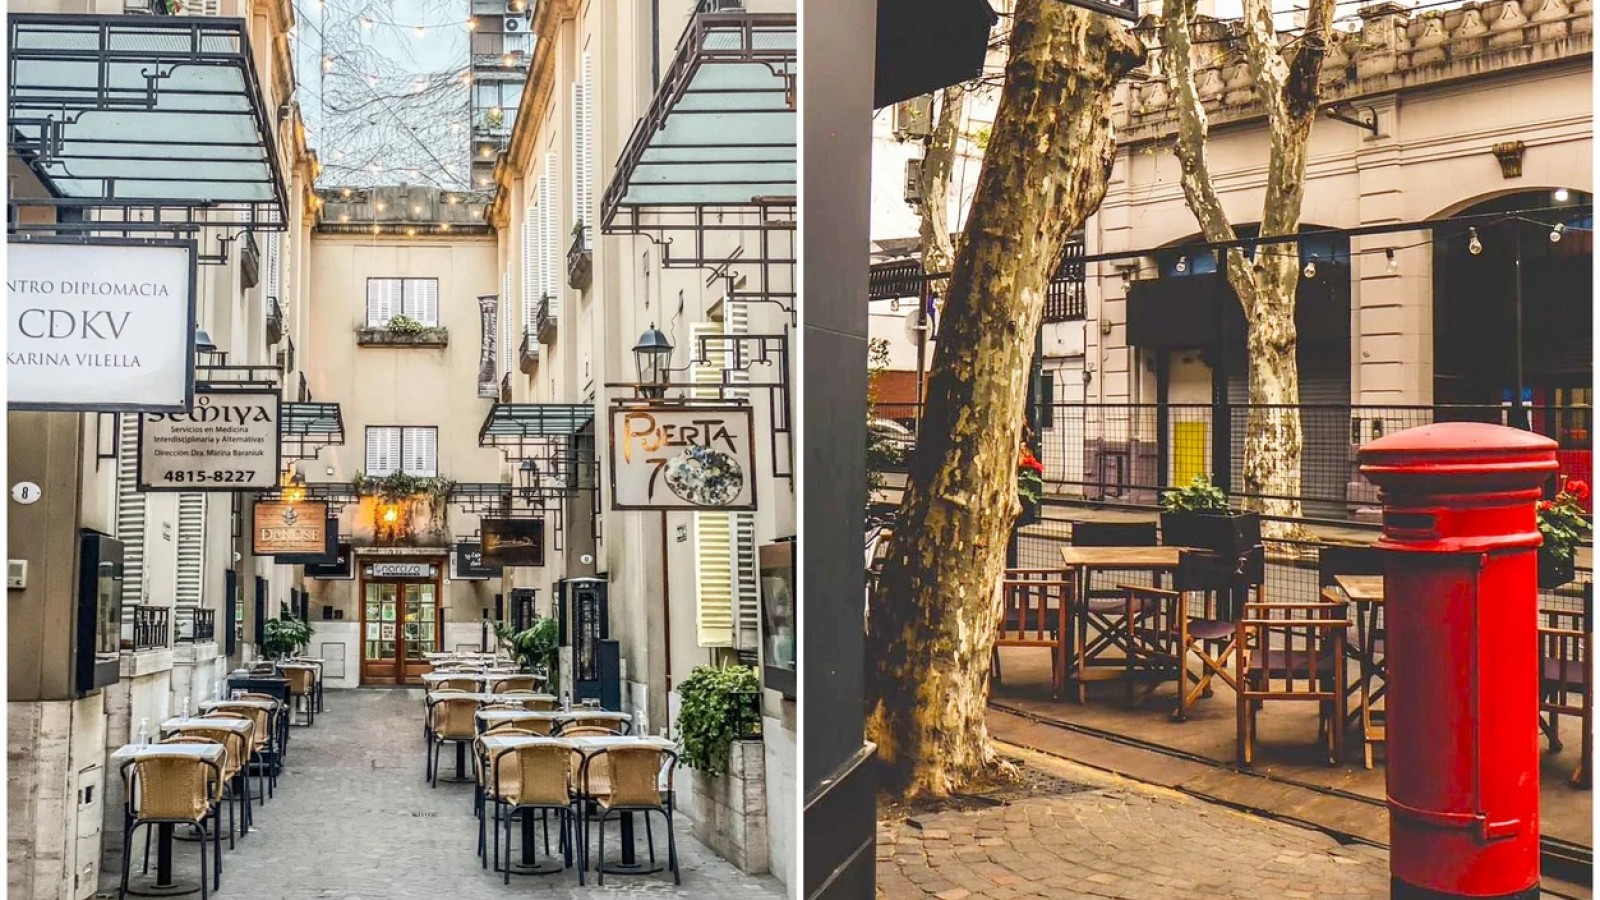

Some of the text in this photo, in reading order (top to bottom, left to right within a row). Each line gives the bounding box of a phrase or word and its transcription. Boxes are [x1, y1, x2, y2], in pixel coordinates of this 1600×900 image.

[60, 281, 169, 297] DIPLOMACIA
[18, 308, 132, 340] CDKV
[7, 352, 141, 368] KARINA VILELLA
[170, 425, 203, 433] Servicios
[215, 425, 249, 433] Medicina
[153, 435, 214, 444] Interdisciplinaria
[221, 435, 265, 443] Alternativas
[164, 470, 256, 482] 4815-8227
[21, 486, 29, 500] 8
